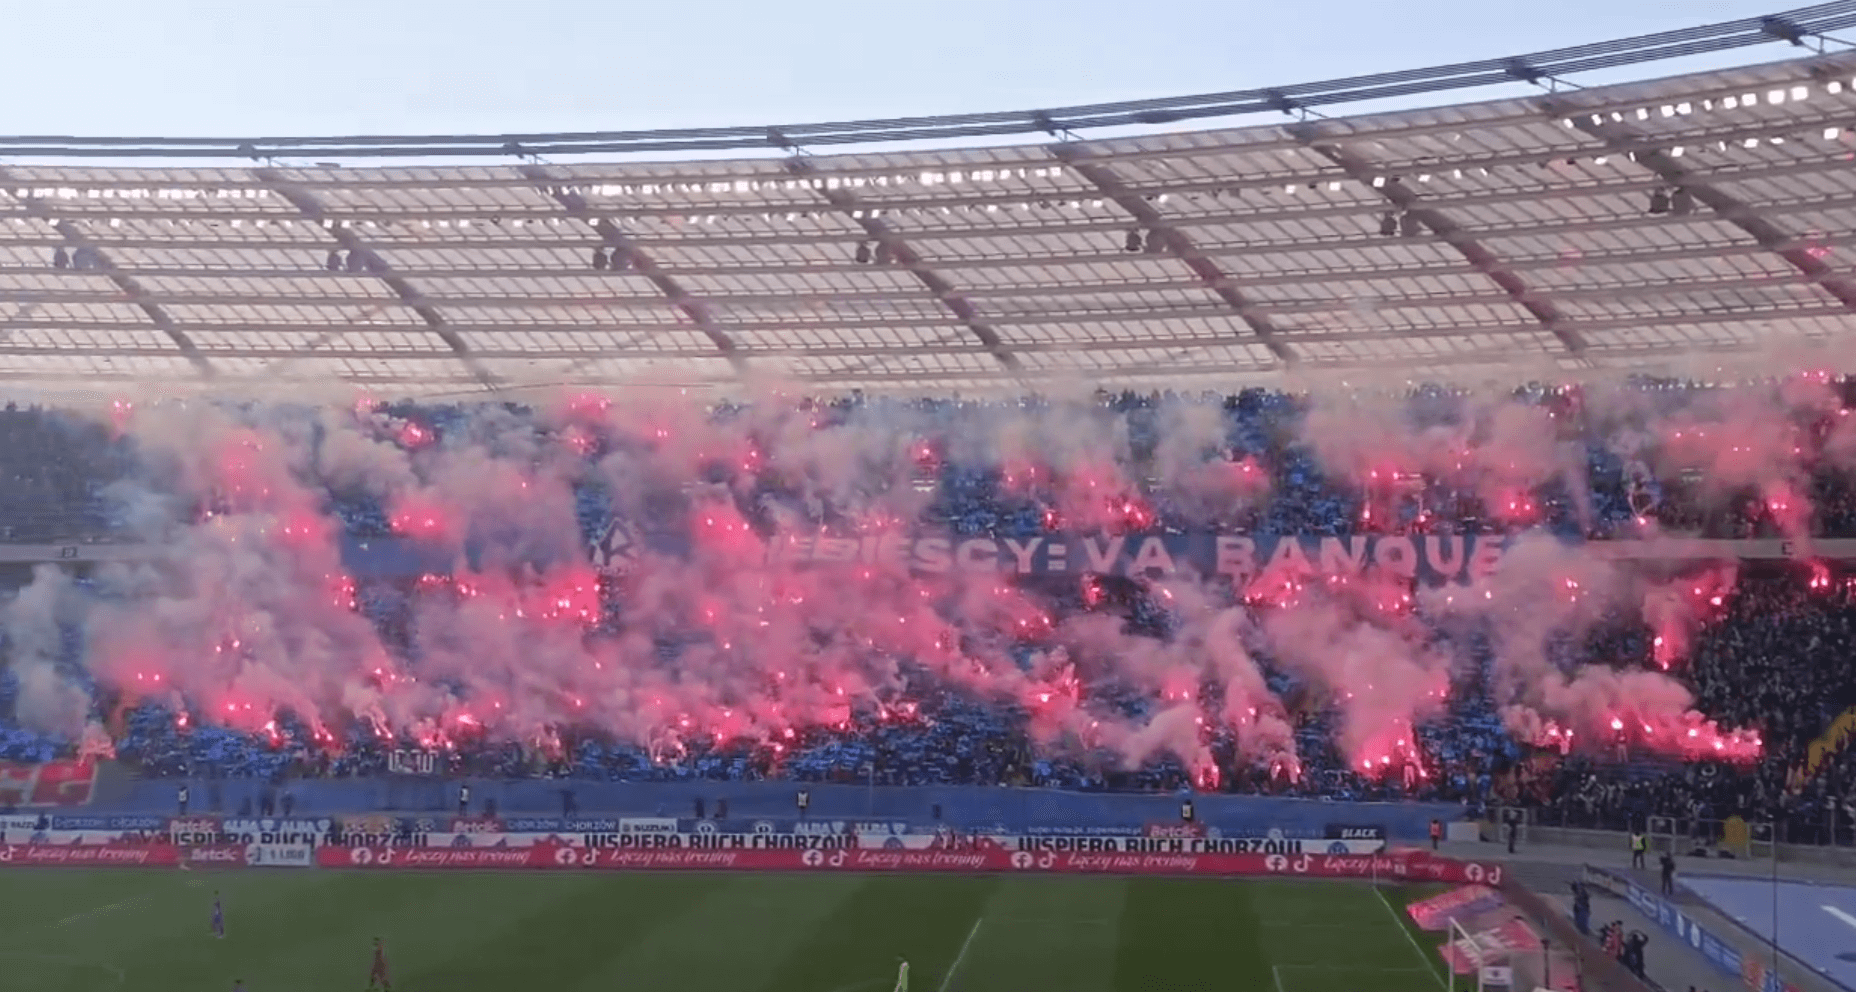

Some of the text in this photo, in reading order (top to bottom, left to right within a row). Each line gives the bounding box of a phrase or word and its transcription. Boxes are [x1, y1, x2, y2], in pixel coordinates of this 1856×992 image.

[768, 535, 1506, 576] IEBIESCY: VA BANQUE
[633, 824, 675, 832] SUZUKI
[1150, 825, 1199, 837] Betclic
[1341, 828, 1378, 838] BLACK
